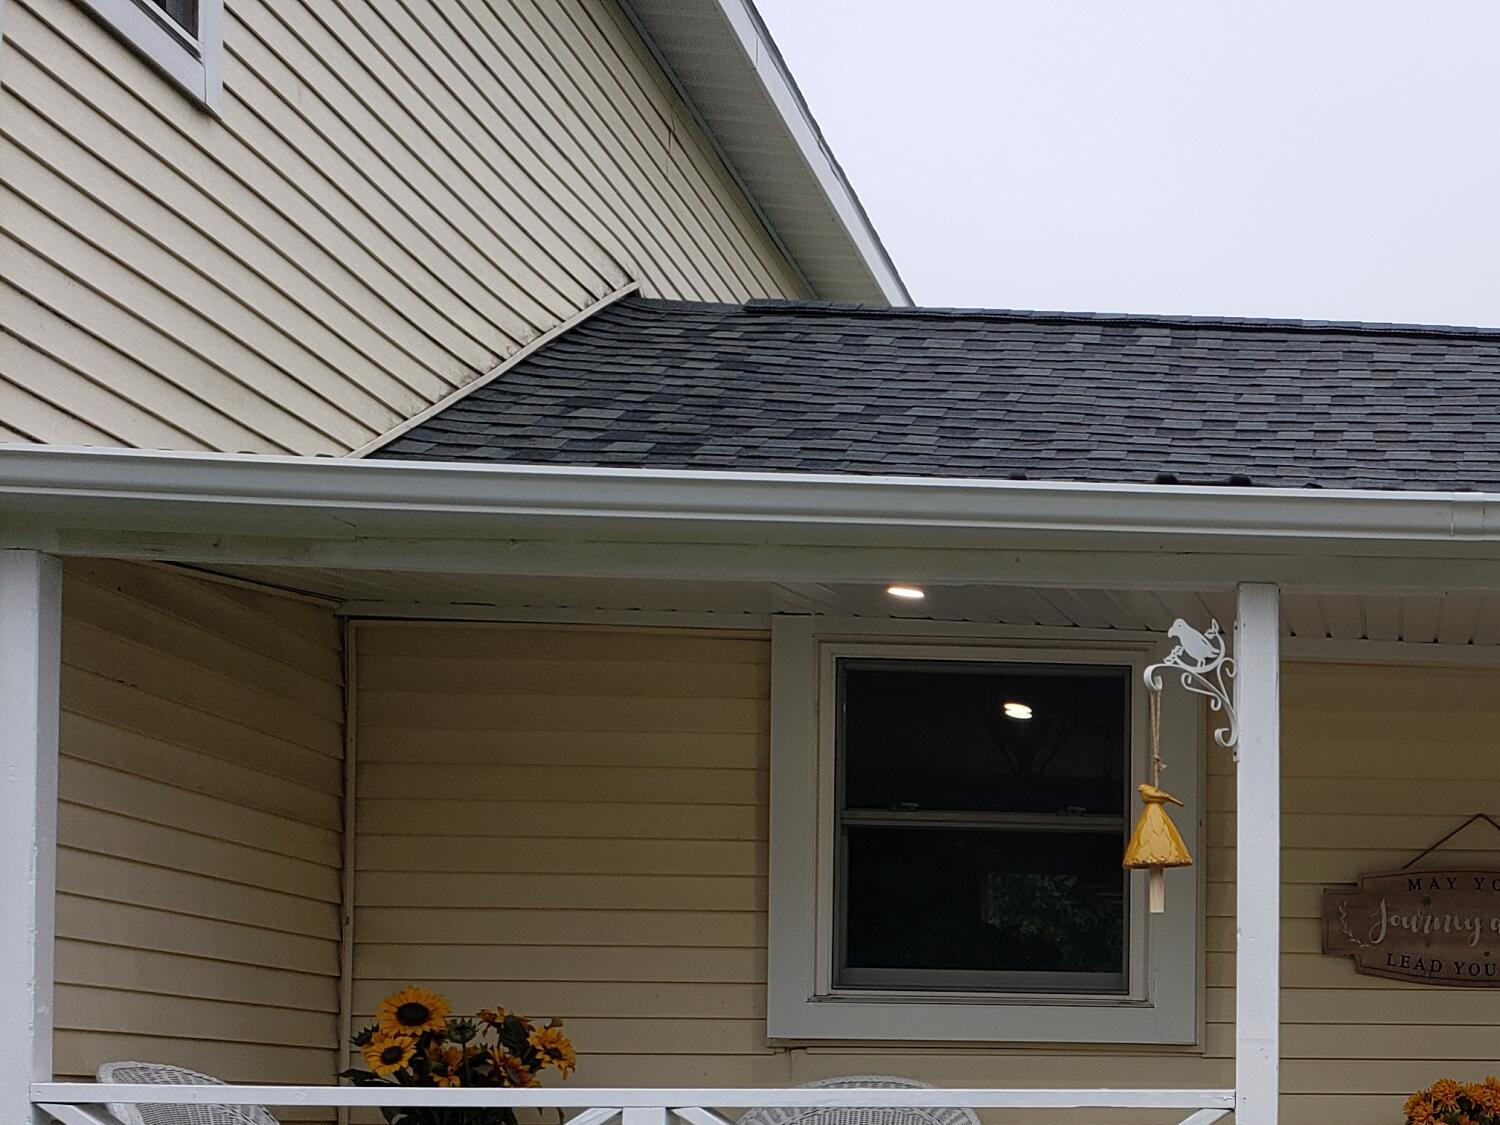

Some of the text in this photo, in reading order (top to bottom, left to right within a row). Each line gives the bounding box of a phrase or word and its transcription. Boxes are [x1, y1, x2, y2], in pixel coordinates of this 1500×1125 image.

[1407, 877, 1457, 891] MAY
[1369, 898, 1484, 947] Journey
[1386, 952, 1443, 973] LEAD
[1454, 962, 1496, 977] YOU
